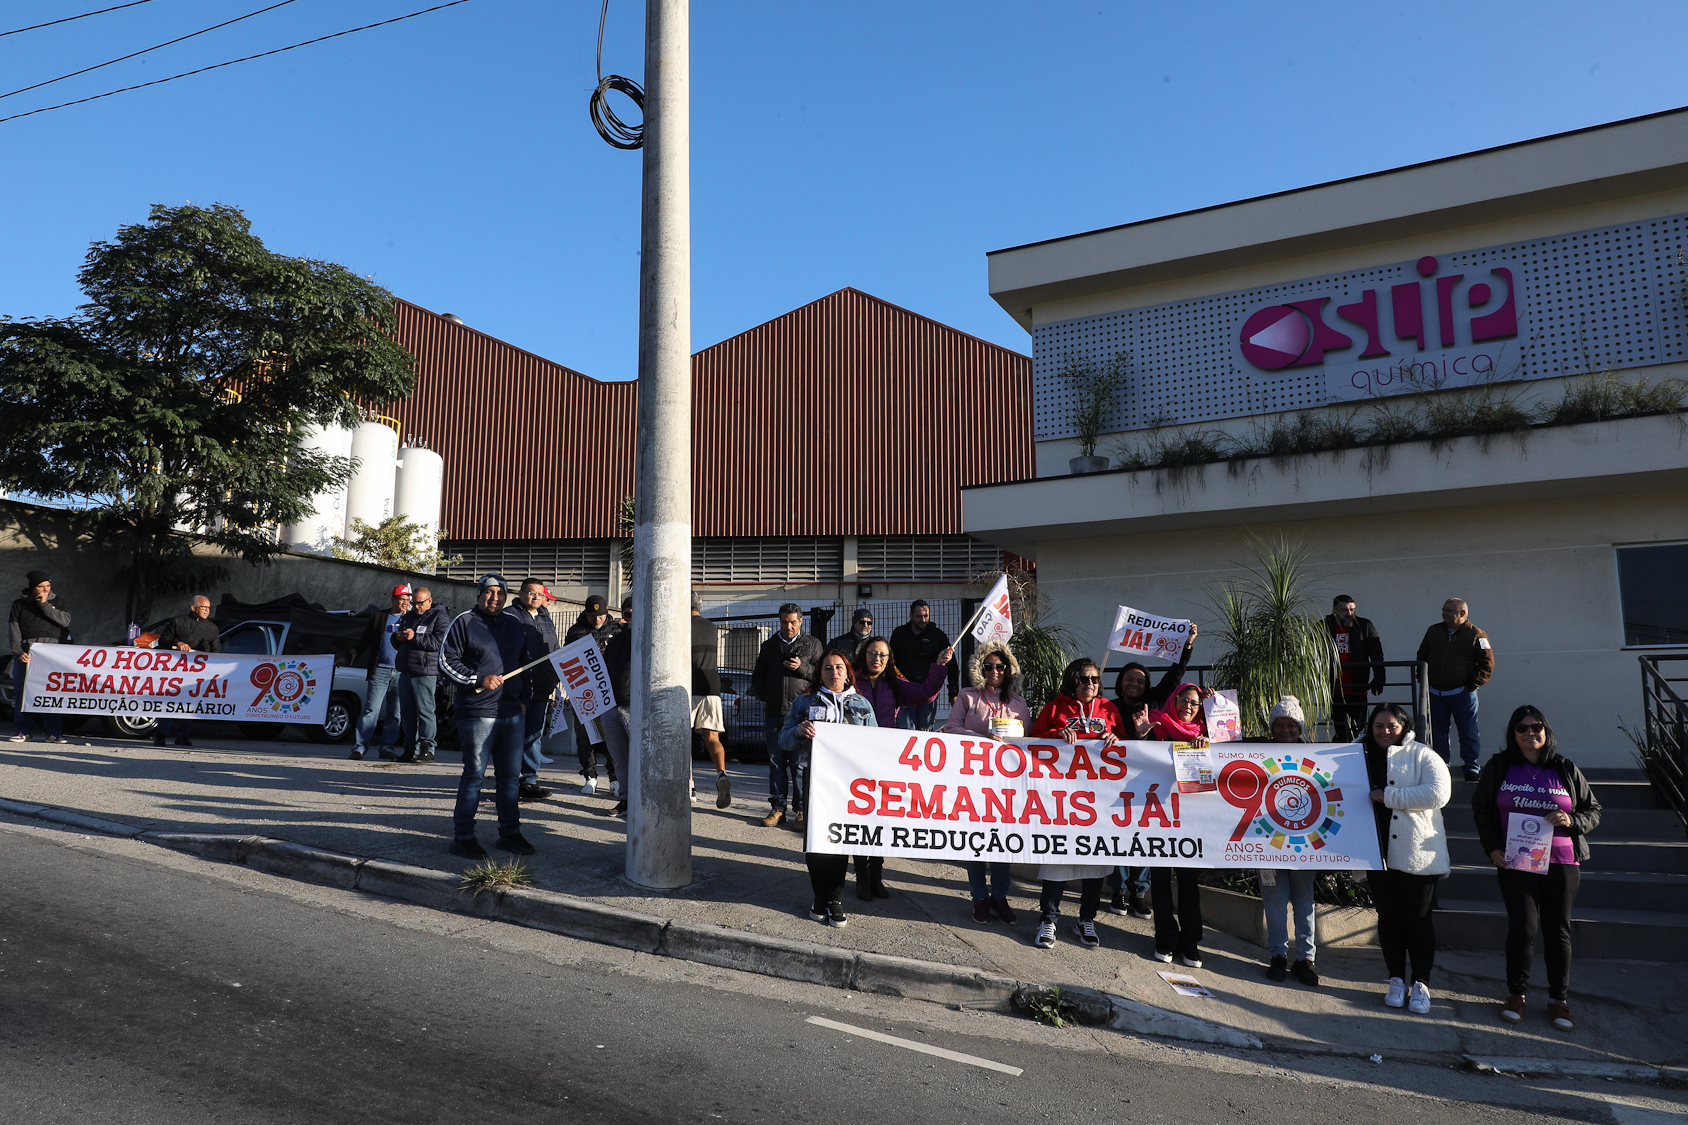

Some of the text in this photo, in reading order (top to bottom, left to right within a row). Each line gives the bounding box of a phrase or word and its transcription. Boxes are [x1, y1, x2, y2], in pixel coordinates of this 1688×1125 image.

[1351, 354, 1494, 395] química
[1126, 612, 1187, 634] REDUÇÃO
[1119, 628, 1153, 652] JÁ!
[76, 649, 209, 673] 40 HORAS
[558, 656, 590, 690] JÁ!
[46, 671, 228, 698] SEMANAIS JÁ!
[583, 648, 611, 706] REDUÇÃO
[33, 696, 236, 716] SEM REDUÇÃO DE SALÁRIO!
[898, 736, 1127, 781] 40 HORAS
[1218, 752, 1244, 760] RUMO
[1248, 752, 1265, 760] AOS
[1272, 776, 1311, 791] QUÍMICOS
[847, 777, 1181, 828] SEMANAIS JÁ!
[827, 823, 1204, 859] SEM REDUÇÃO DE SALÁRIO!
[1225, 843, 1264, 854] ANOS
[1224, 854, 1352, 864] CONSTRUINDO O FUTURO
